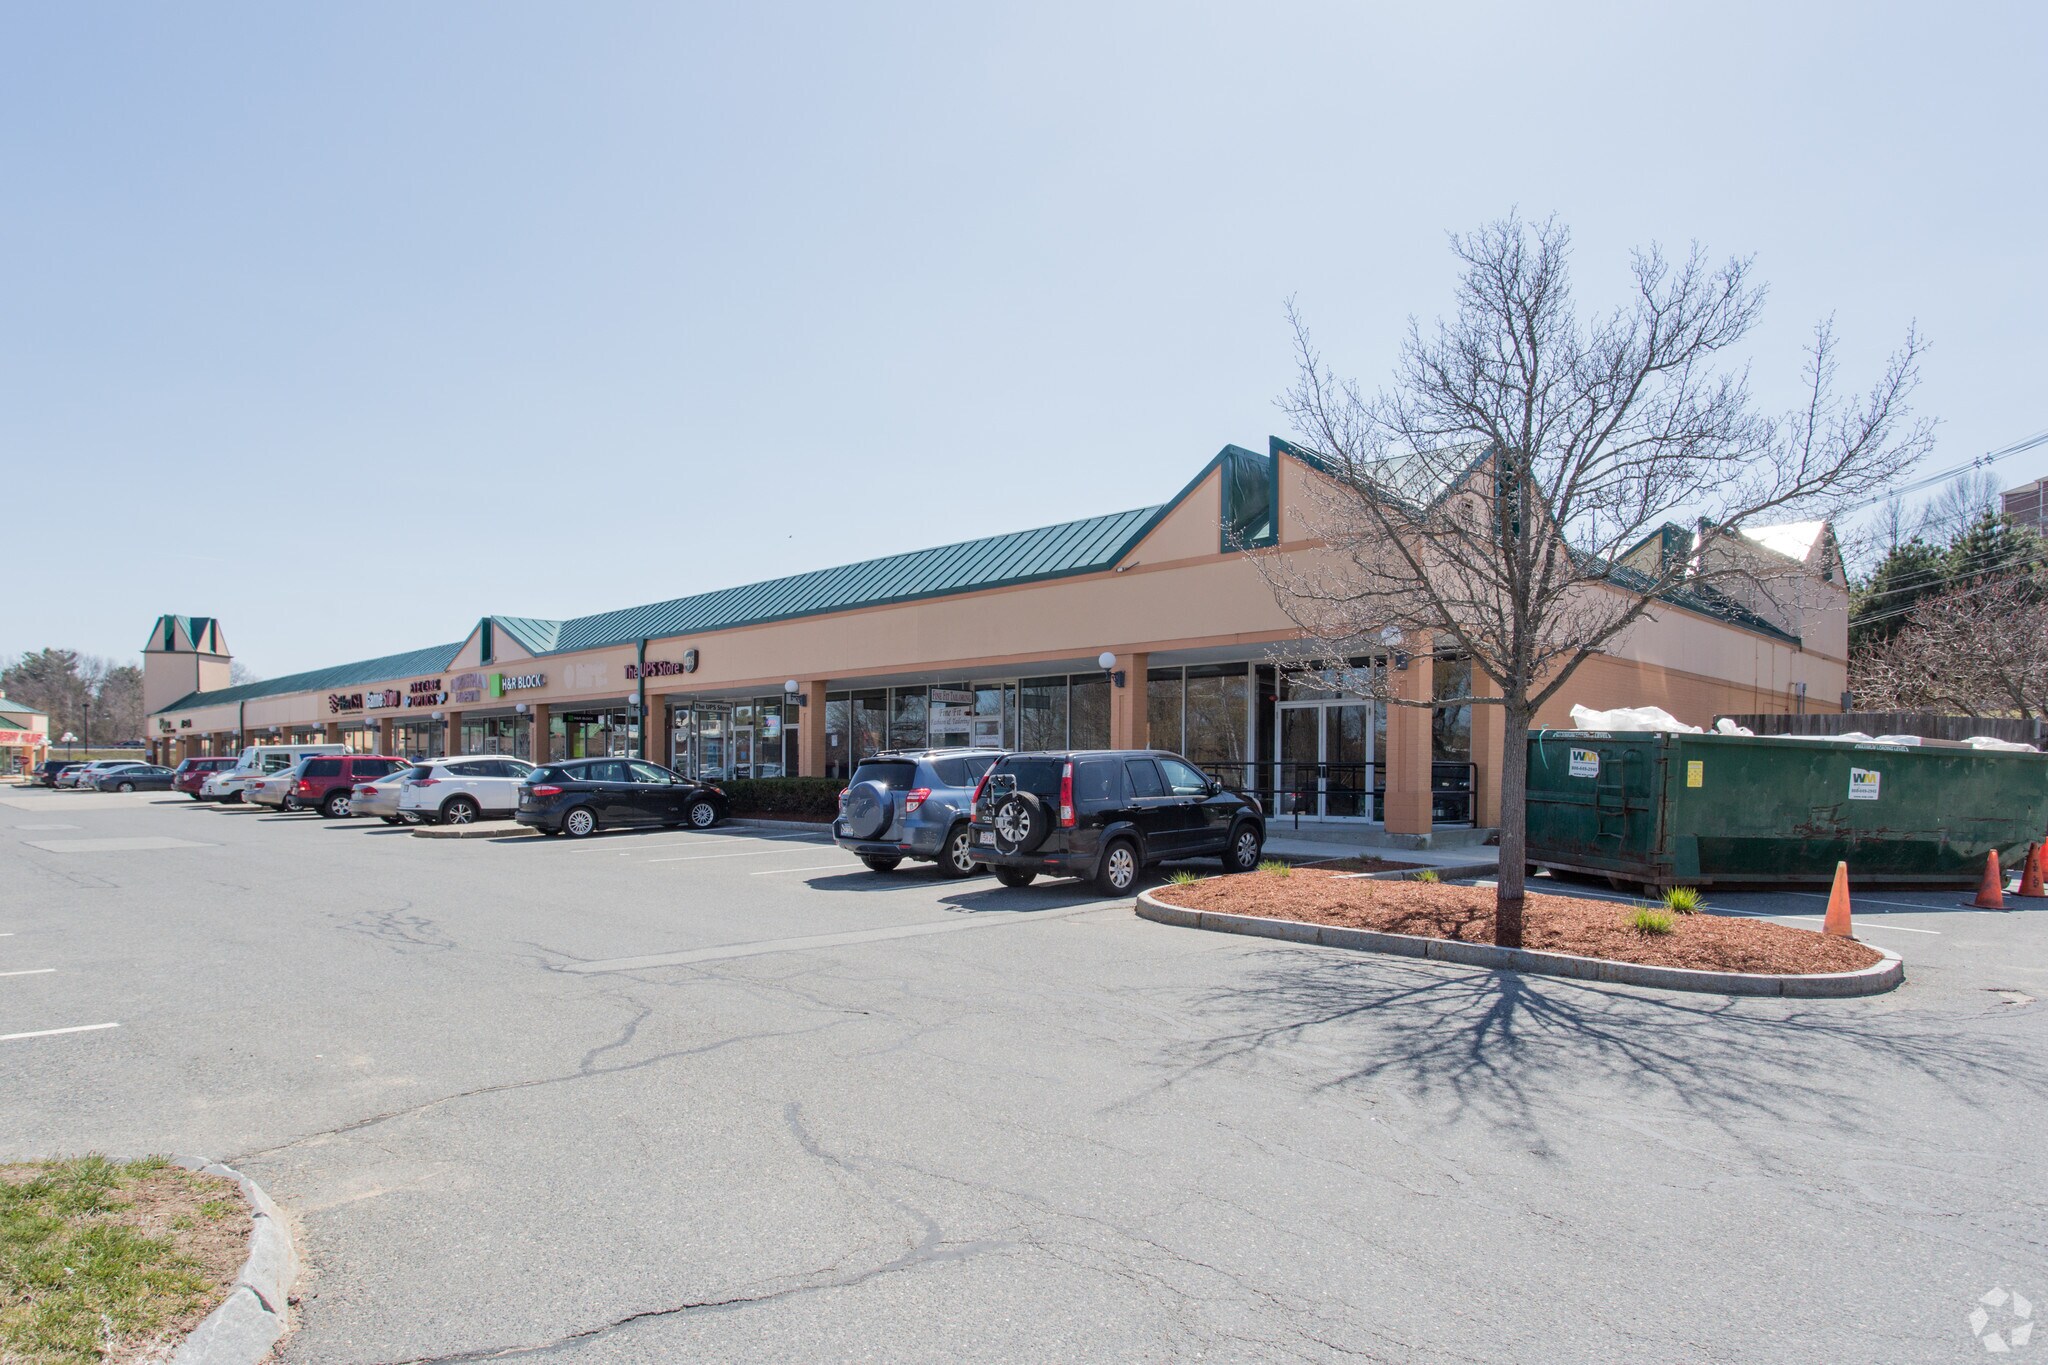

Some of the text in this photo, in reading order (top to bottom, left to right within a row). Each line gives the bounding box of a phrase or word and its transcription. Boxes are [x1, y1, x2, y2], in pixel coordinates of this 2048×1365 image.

[624, 664, 639, 680] The
[640, 661, 657, 678] UPS
[658, 660, 682, 677] Store
[502, 677, 517, 691] H&R
[518, 673, 543, 689] BLOCK
[932, 689, 942, 700] FINE
[717, 704, 731, 712] Store
[1573, 751, 1597, 762] WM
[1853, 773, 1877, 784] WM
